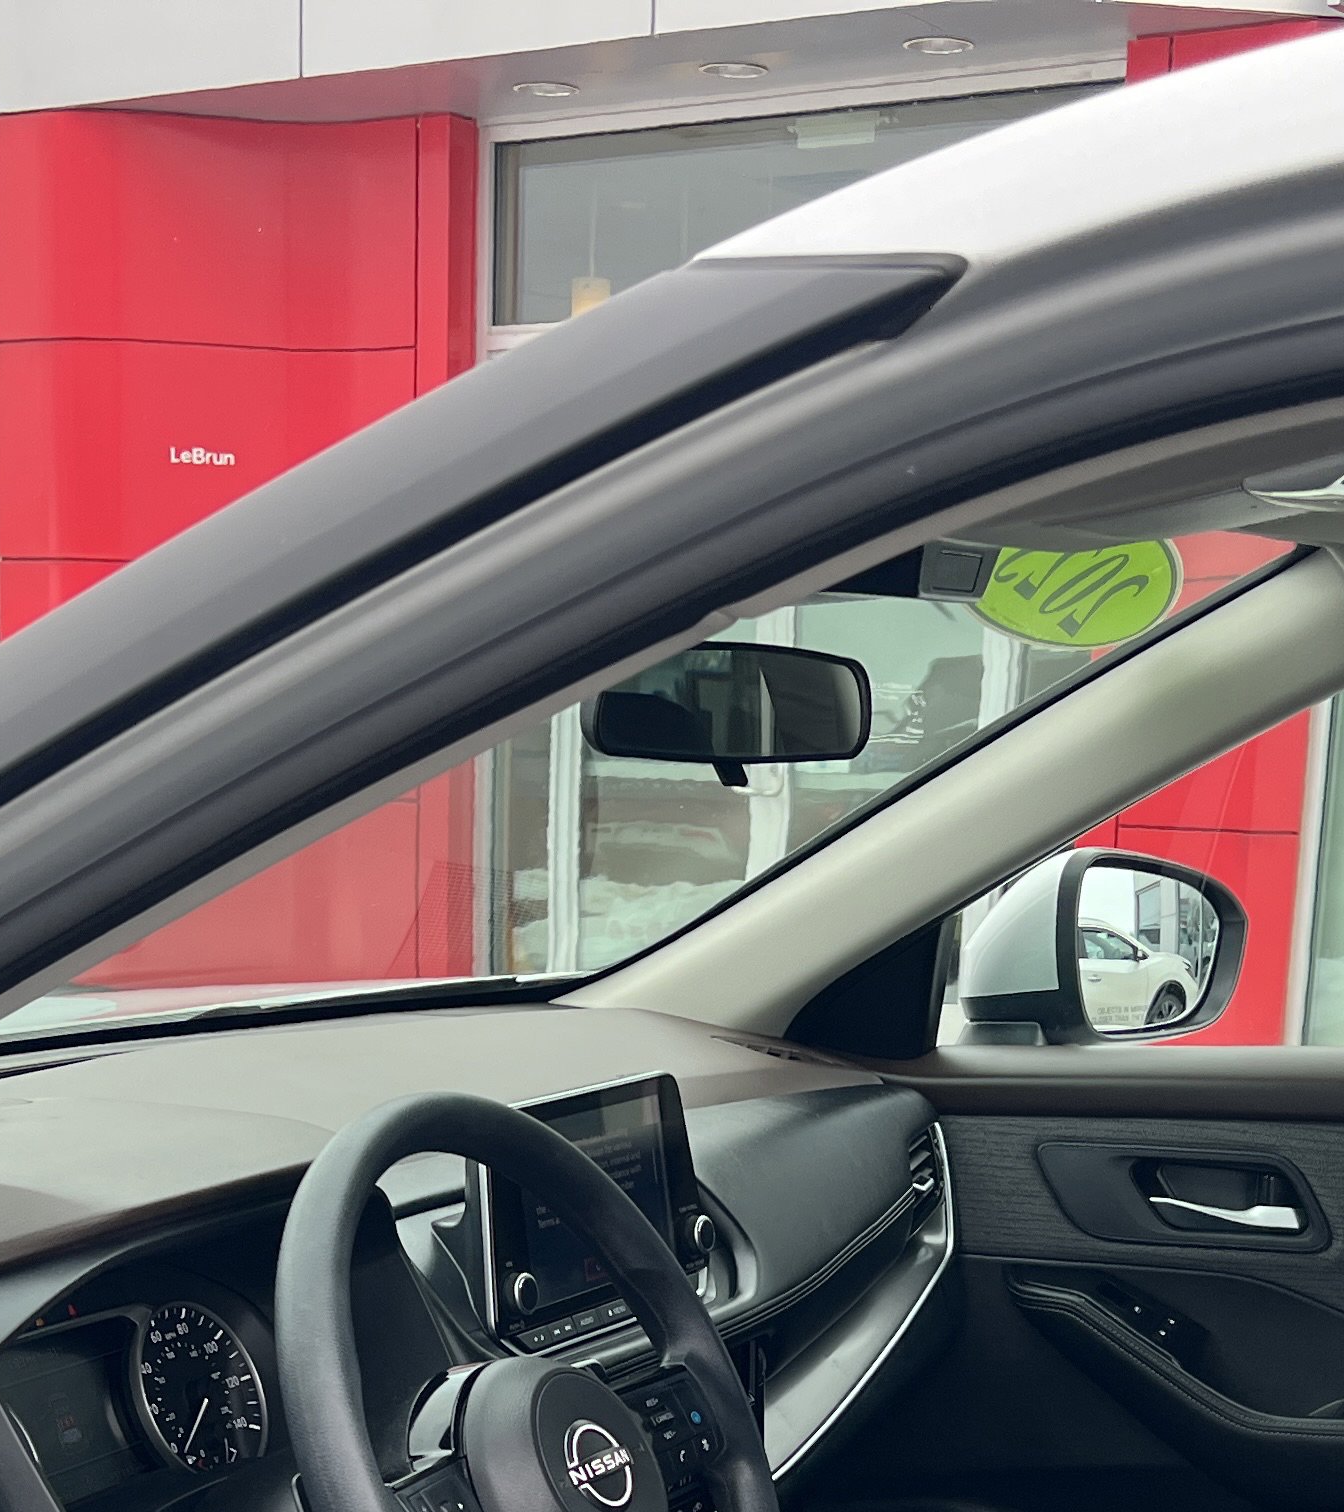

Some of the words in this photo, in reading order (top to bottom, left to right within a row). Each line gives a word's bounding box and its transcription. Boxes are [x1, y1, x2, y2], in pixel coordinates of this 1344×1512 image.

[169, 446, 235, 465] LeBrun
[176, 1322, 189, 1335] 80
[150, 1330, 162, 1343] 60
[203, 1340, 218, 1354] 100
[225, 1375, 240, 1389] 120
[568, 1449, 631, 1487] NISSAN
